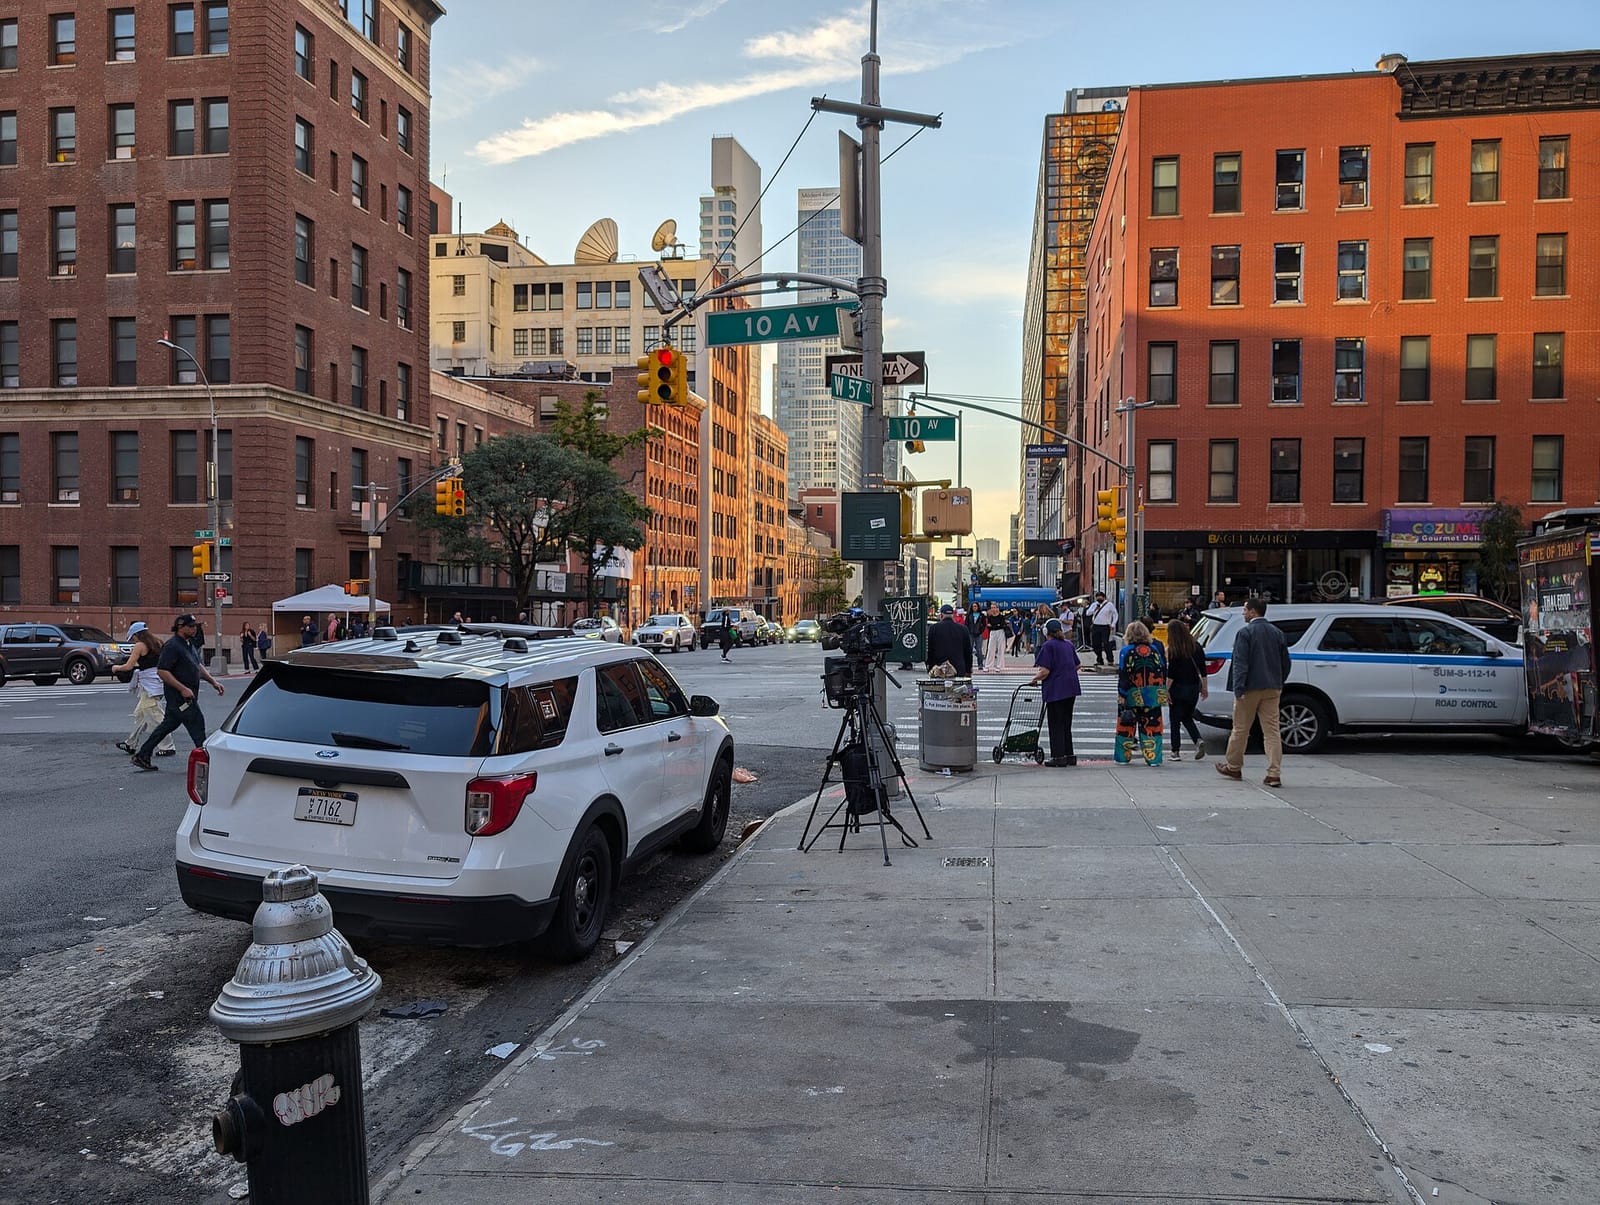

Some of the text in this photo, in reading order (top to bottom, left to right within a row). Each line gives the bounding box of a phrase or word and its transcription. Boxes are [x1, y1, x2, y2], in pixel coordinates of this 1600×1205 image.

[745, 314, 820, 337] 10 Av
[839, 362, 909, 378] ONE WAY
[834, 377, 872, 399] W 57 ST
[904, 419, 939, 438] 10 AV
[1412, 522, 1482, 535] COZUME
[1422, 534, 1460, 542] Gourmet
[1529, 542, 1574, 561] BITE OF THAI
[1433, 669, 1496, 678] SUM-S-112-14
[1435, 699, 1498, 709] ROAD CONTROL
[316, 799, 342, 817] 7162
